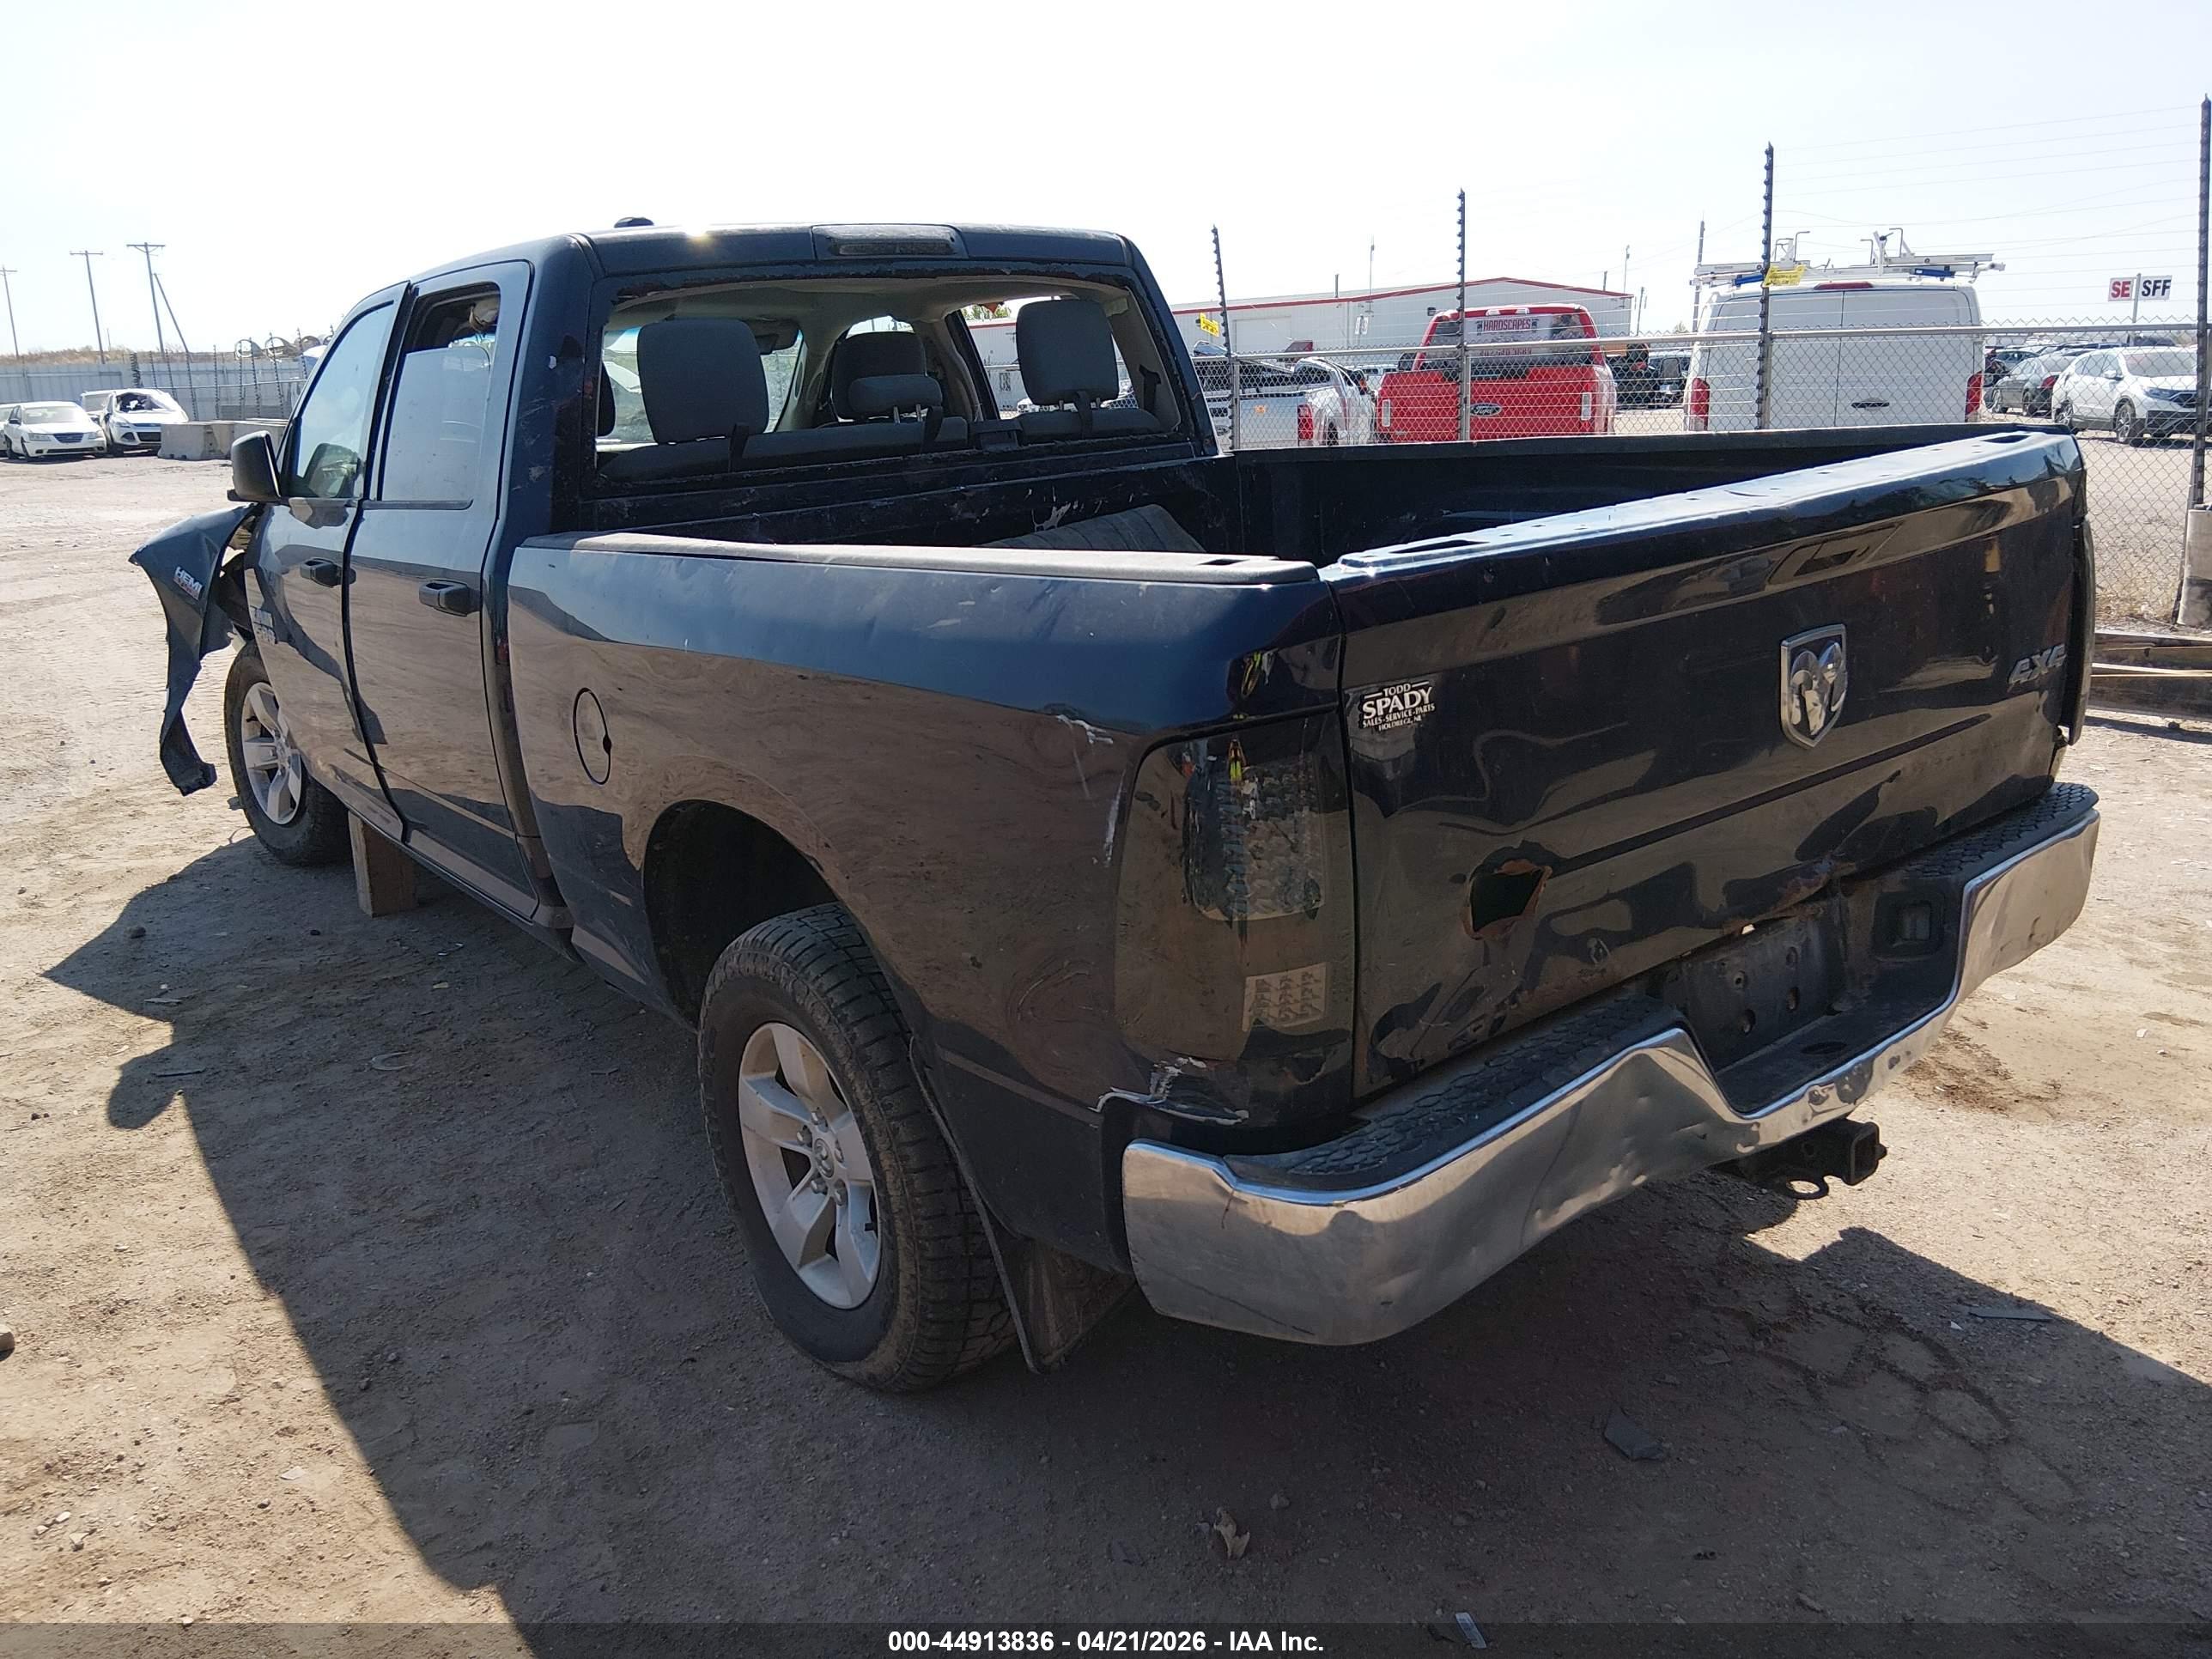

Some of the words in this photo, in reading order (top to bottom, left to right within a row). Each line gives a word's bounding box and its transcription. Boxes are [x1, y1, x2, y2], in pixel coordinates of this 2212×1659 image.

[2111, 281, 2131, 298] SE
[2142, 279, 2172, 297] SFF
[1483, 319, 1531, 331] HARDSCAPES
[174, 566, 203, 592] HEMI
[1382, 683, 1411, 697] TODD
[1362, 686, 1433, 720] SPADY
